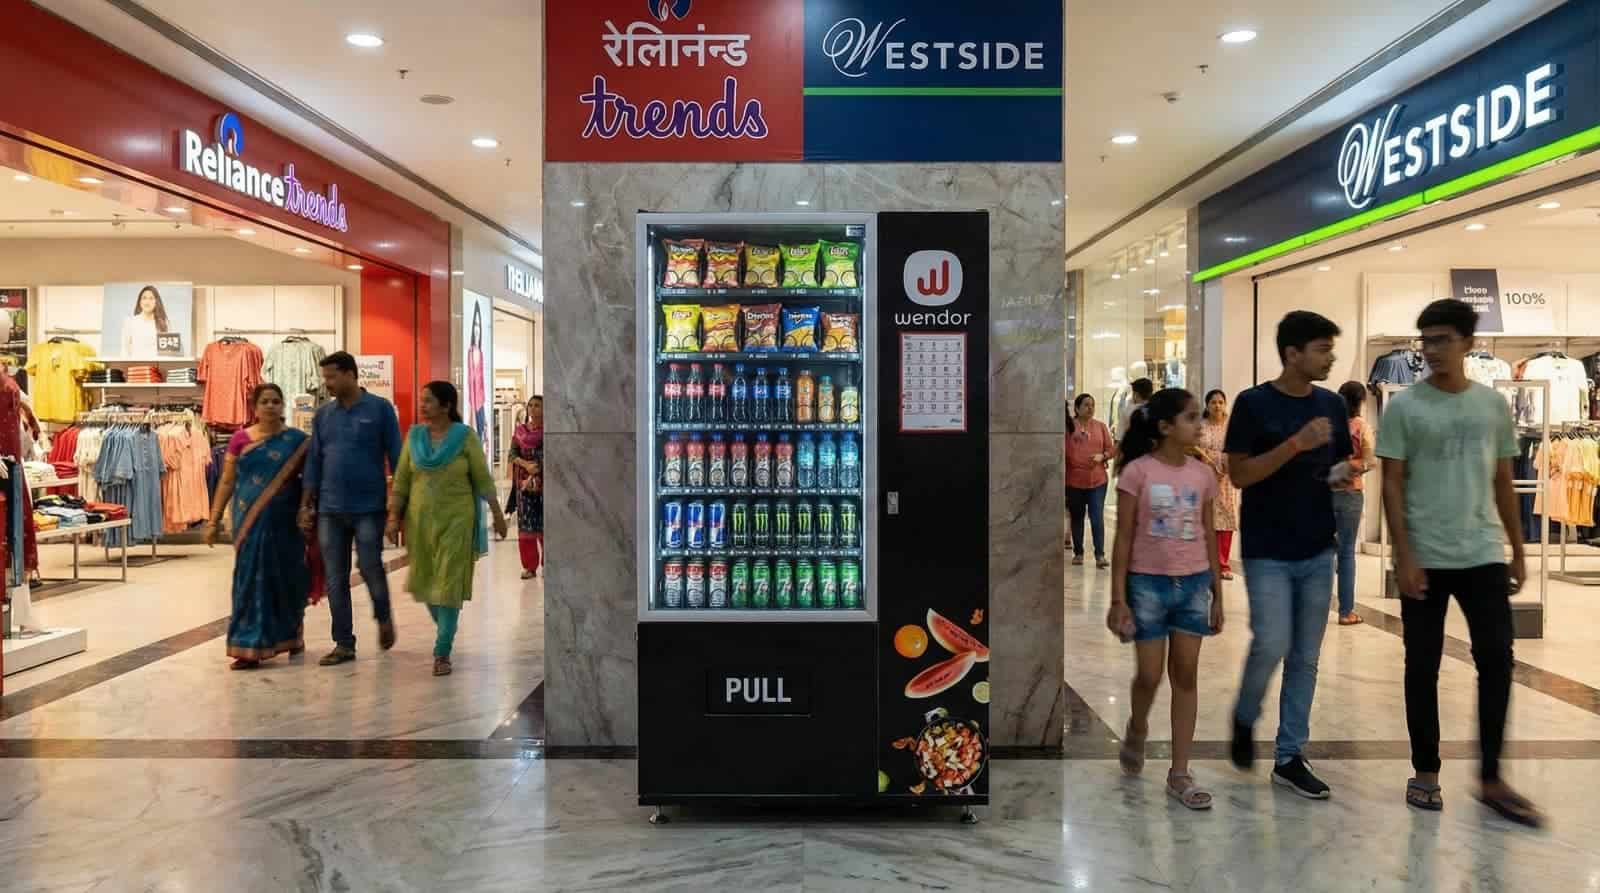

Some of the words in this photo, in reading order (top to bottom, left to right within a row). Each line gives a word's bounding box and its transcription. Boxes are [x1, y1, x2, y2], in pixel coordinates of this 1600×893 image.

[823, 17, 1045, 78] WESTSIDE
[579, 75, 769, 140] trends
[1337, 63, 1551, 209] WESTSIDE
[184, 129, 285, 208] Reliance
[284, 163, 349, 233] trends
[894, 309, 972, 326] wendor
[1505, 292, 1546, 305] 100%
[725, 677, 792, 703] PULL
